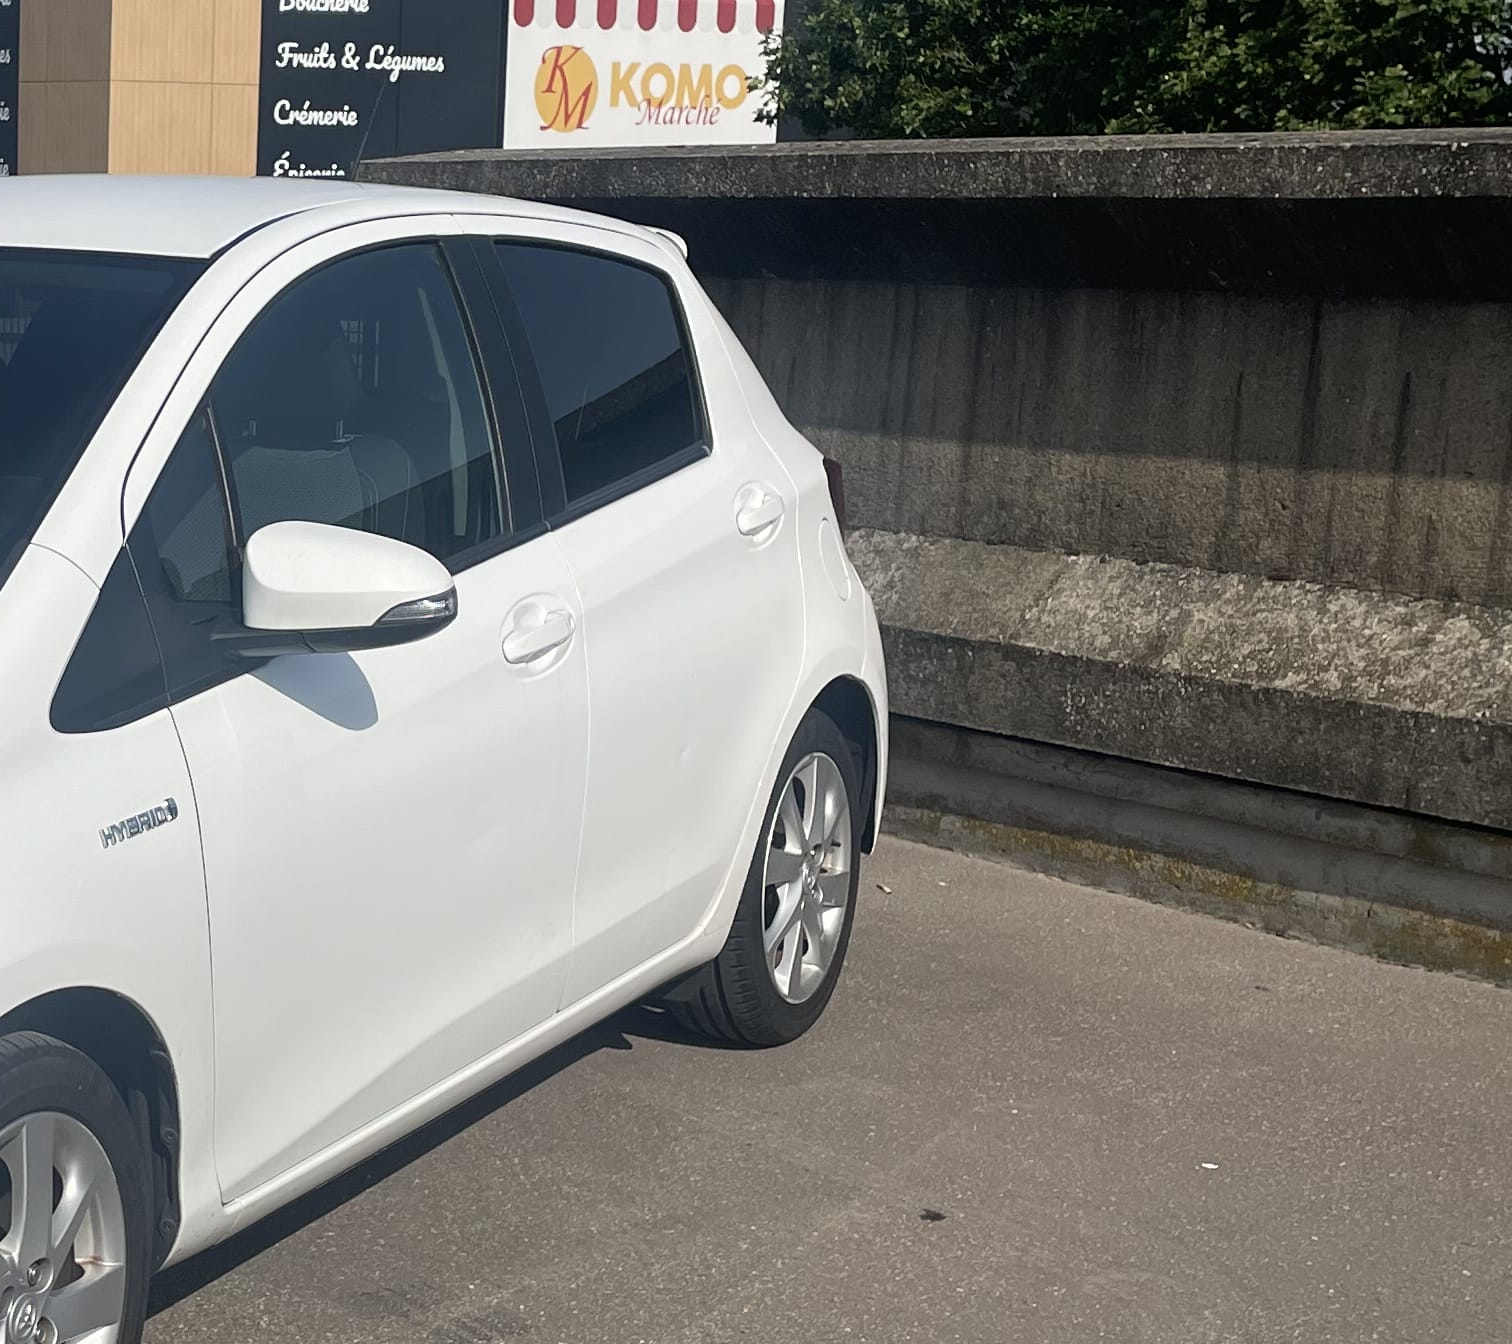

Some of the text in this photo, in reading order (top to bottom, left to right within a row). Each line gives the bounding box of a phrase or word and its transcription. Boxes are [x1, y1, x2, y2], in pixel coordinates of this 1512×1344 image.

[275, 41, 445, 82] Fruits & Légumes
[609, 61, 748, 110] KOMO
[273, 99, 358, 126] Crémerie
[635, 94, 722, 127] Marché
[99, 805, 167, 849] HYBRID
